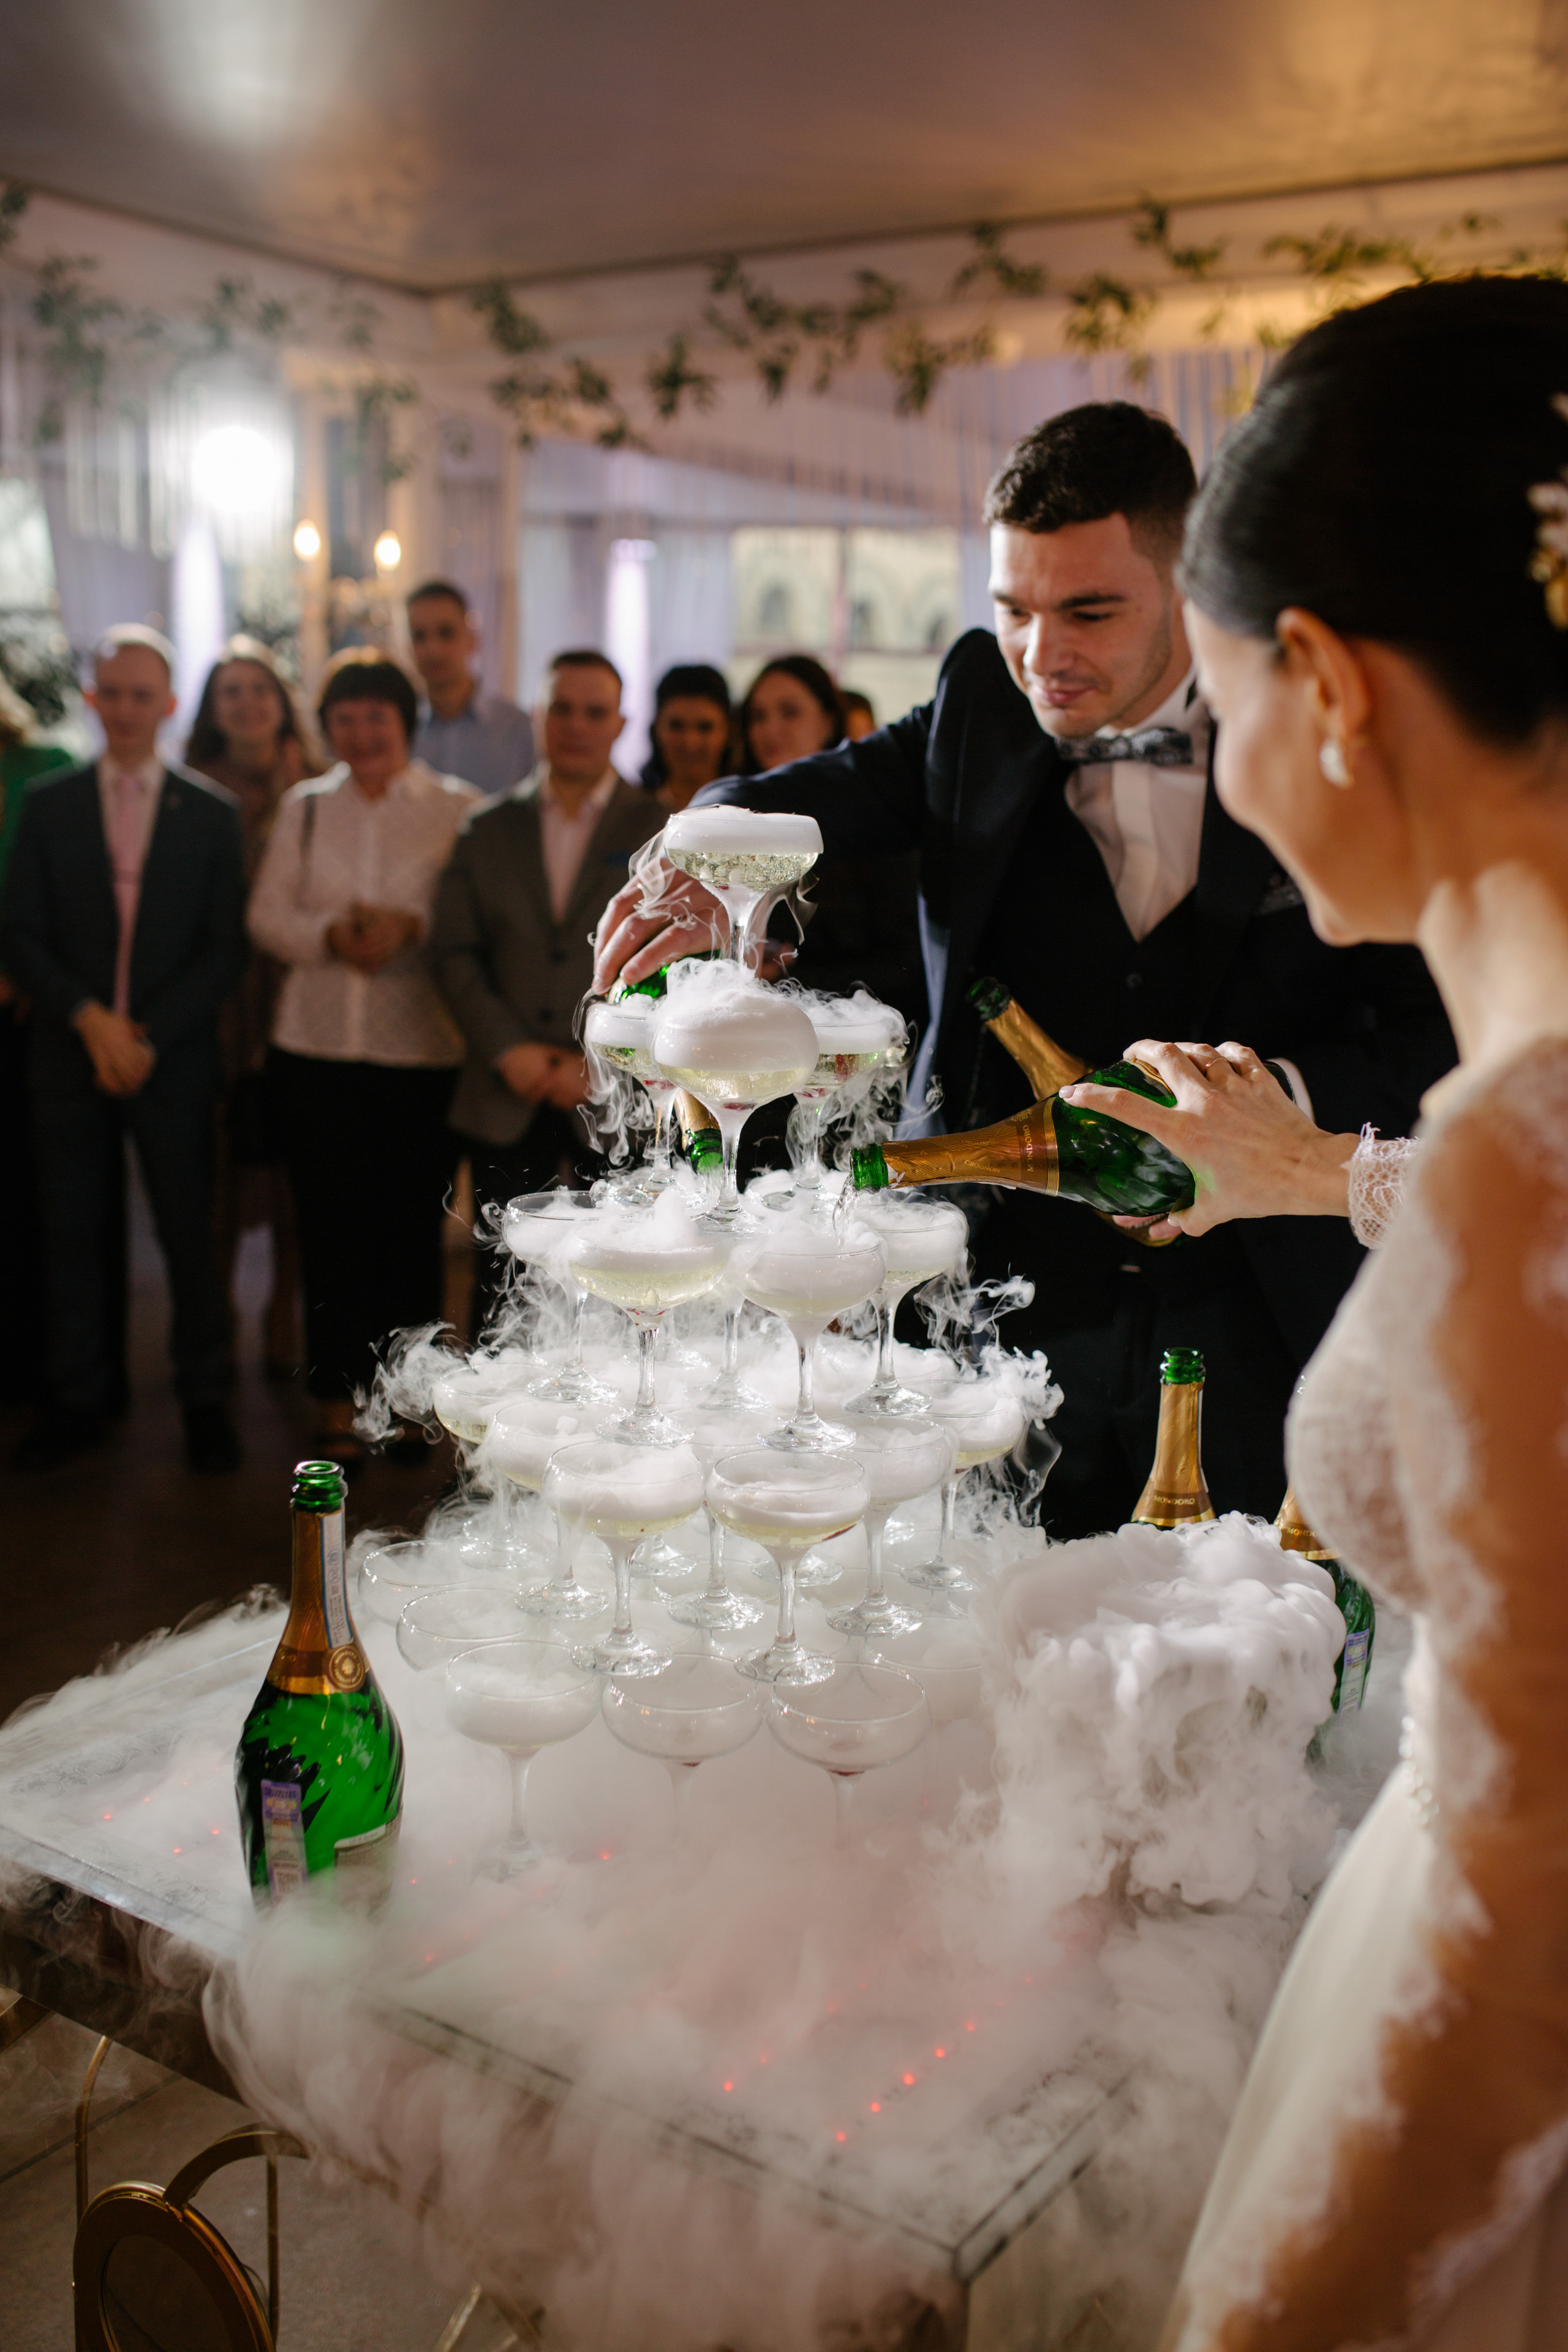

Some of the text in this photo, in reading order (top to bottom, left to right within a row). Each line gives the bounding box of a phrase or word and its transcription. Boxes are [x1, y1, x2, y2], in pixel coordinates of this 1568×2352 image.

[1023, 1125, 1034, 1172] MONDORO
[964, 1159, 1001, 1174] MONDORO
[1286, 1527, 1319, 1537] MONDO
